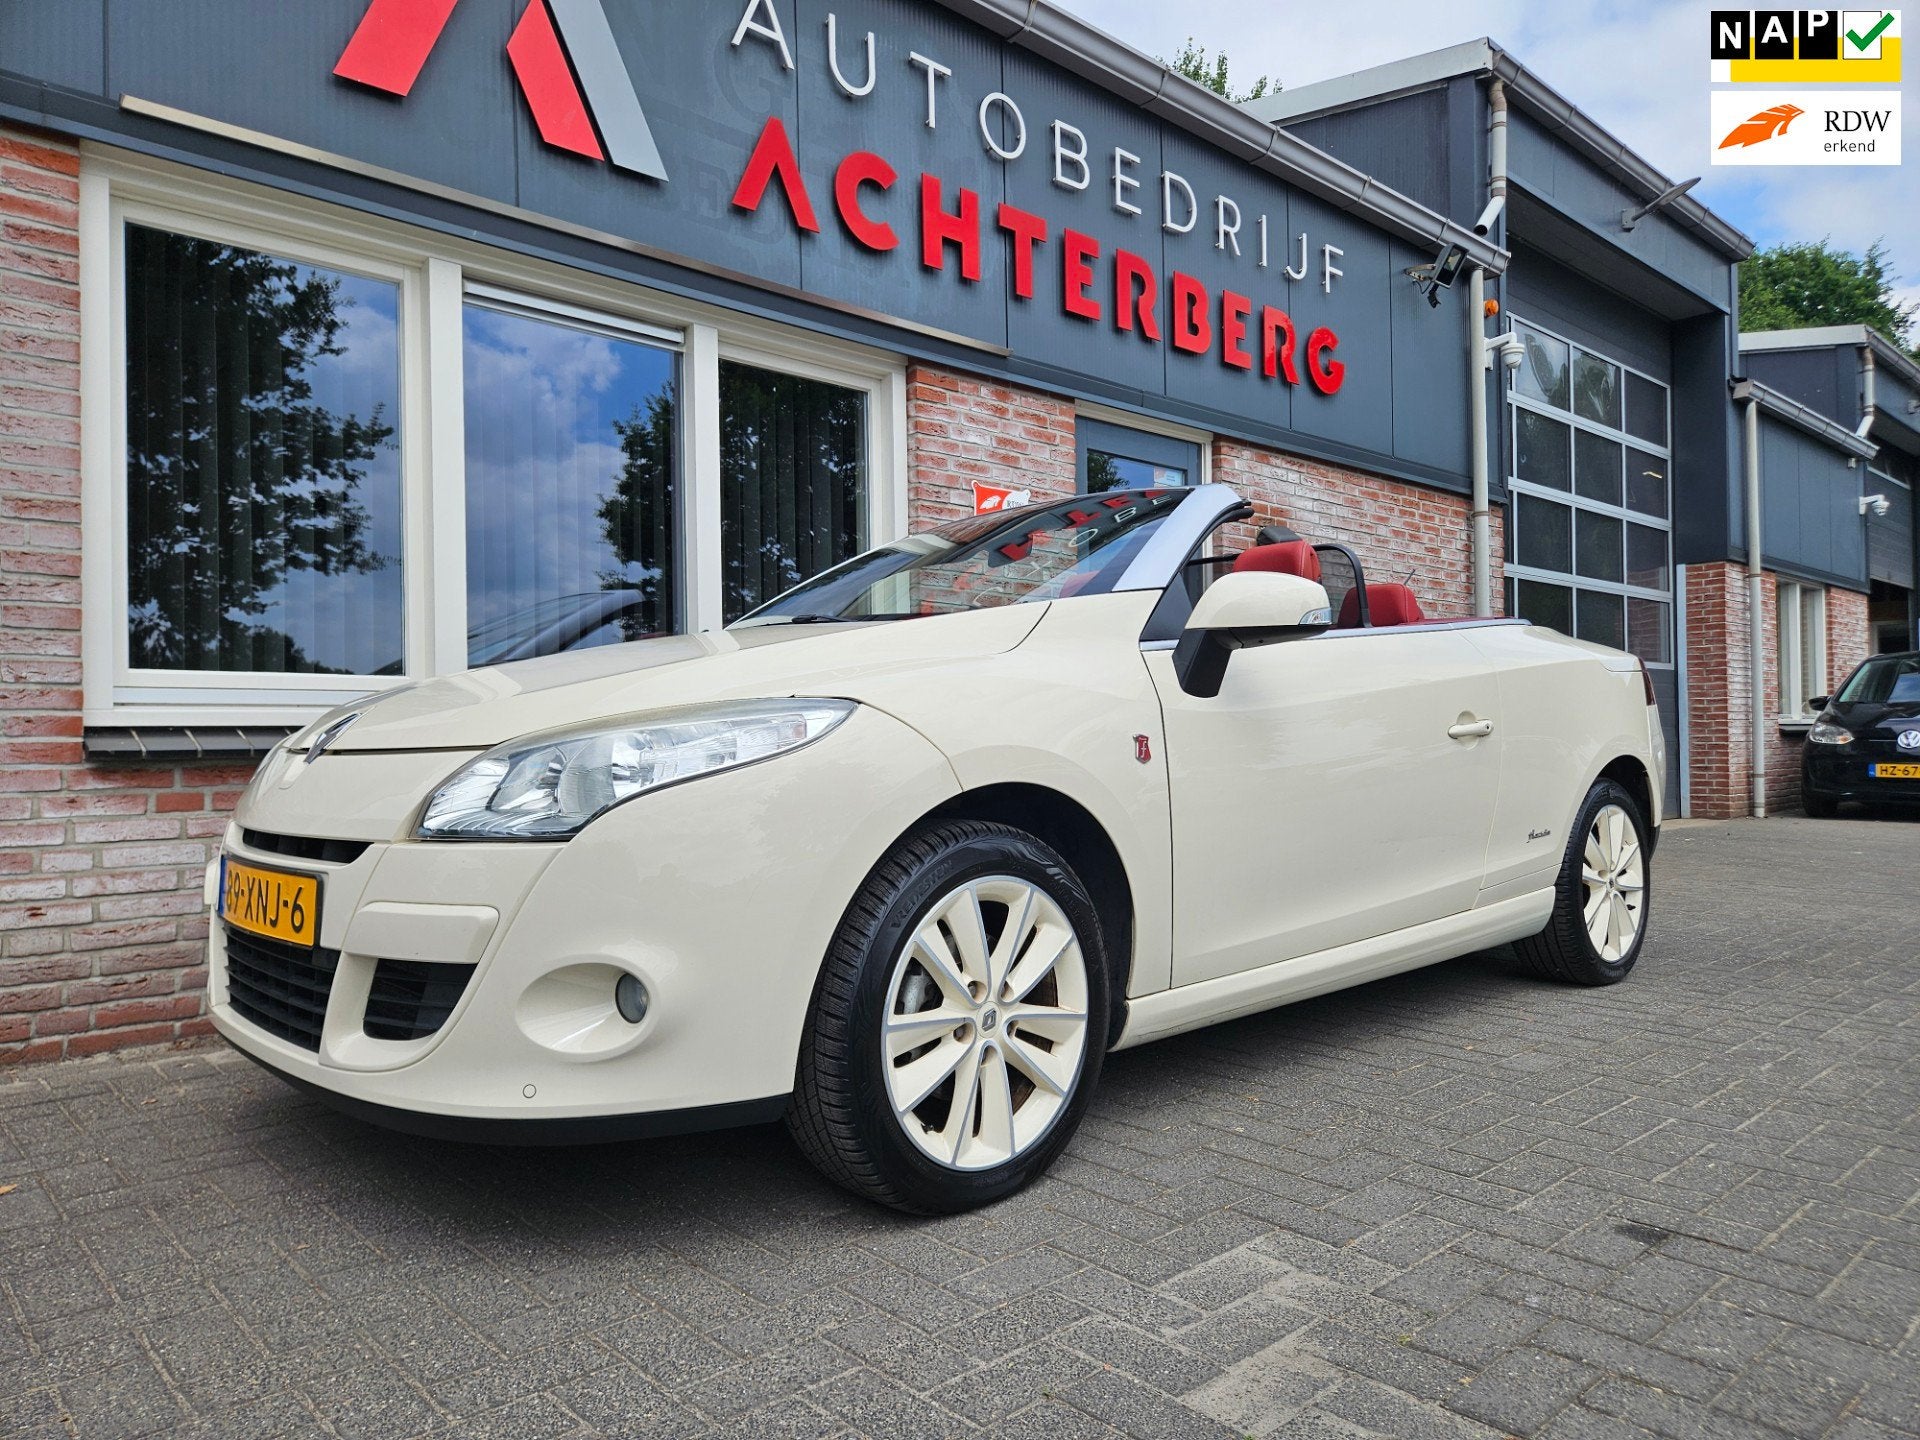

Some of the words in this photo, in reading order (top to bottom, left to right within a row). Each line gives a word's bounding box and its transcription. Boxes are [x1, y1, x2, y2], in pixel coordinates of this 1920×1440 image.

[731, 0, 1344, 293] AUTOBEDRIJF
[731, 116, 1345, 395] ACHTERBERG
[1879, 765, 1920, 776] HZ-67
[226, 869, 304, 933] 89-XNJ-6
